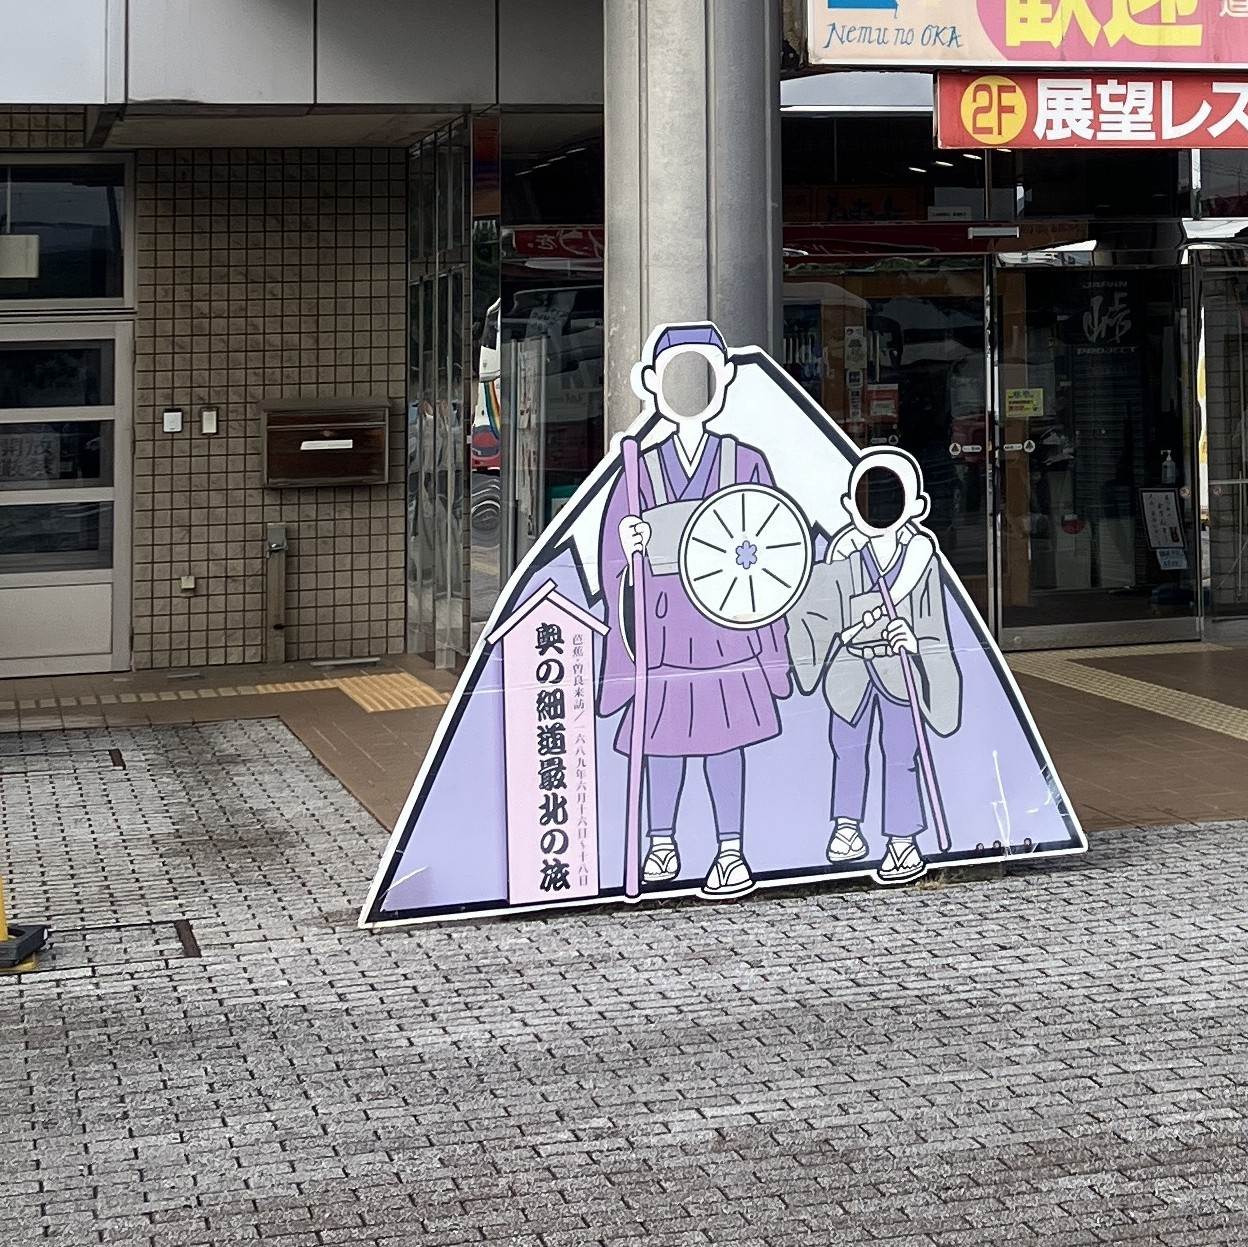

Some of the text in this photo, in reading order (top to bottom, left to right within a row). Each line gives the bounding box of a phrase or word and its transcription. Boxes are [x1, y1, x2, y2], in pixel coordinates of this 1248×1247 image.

[823, 22, 962, 49] Nemu no OKA
[972, 84, 1017, 138] 2F
[535, 622, 571, 893] 奥の細道最北の旅
